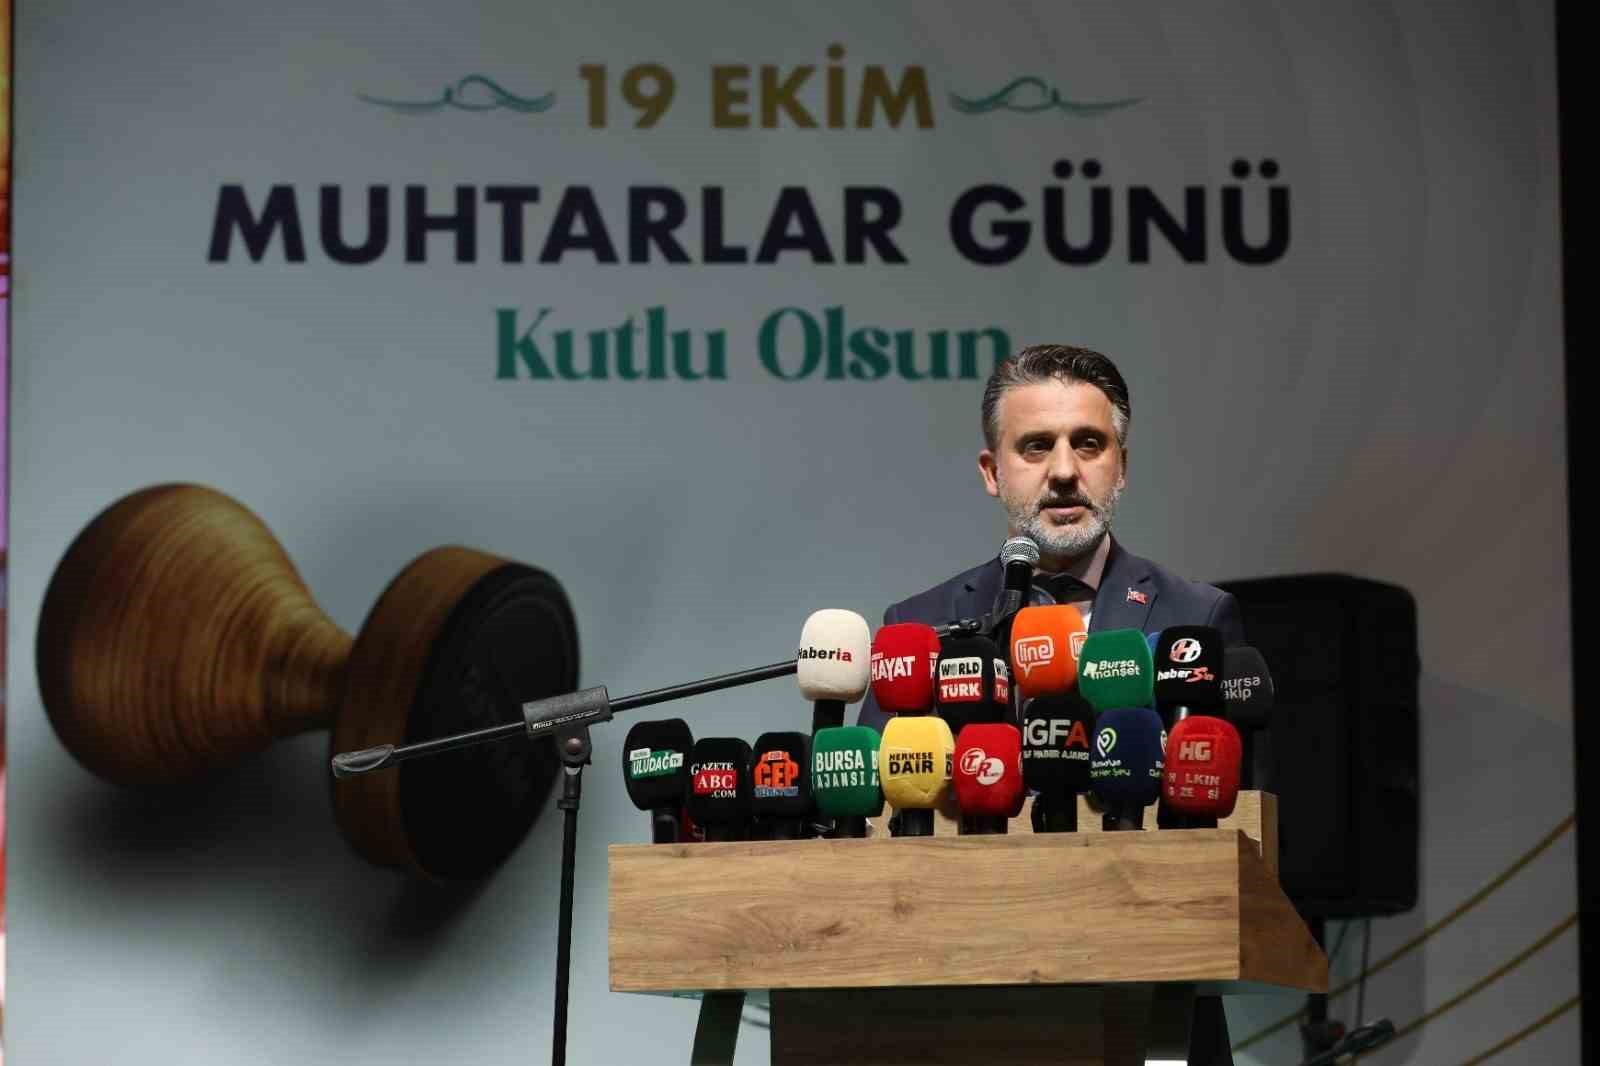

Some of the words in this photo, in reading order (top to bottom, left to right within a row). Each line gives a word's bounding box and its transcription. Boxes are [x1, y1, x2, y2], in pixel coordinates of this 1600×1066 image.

[579, 63, 677, 129] 19
[712, 43, 935, 130] EKİM
[206, 184, 908, 266] MUHTARLAR
[948, 158, 1292, 268] GÜNÜ
[495, 306, 728, 382] Kutlu
[758, 306, 1011, 382] Olsun
[1099, 660, 1135, 671] Bursa
[815, 749, 865, 773] BURSA
[1179, 741, 1211, 760] HG
[690, 762, 734, 776] GAZETE
[697, 774, 734, 789] ABC
